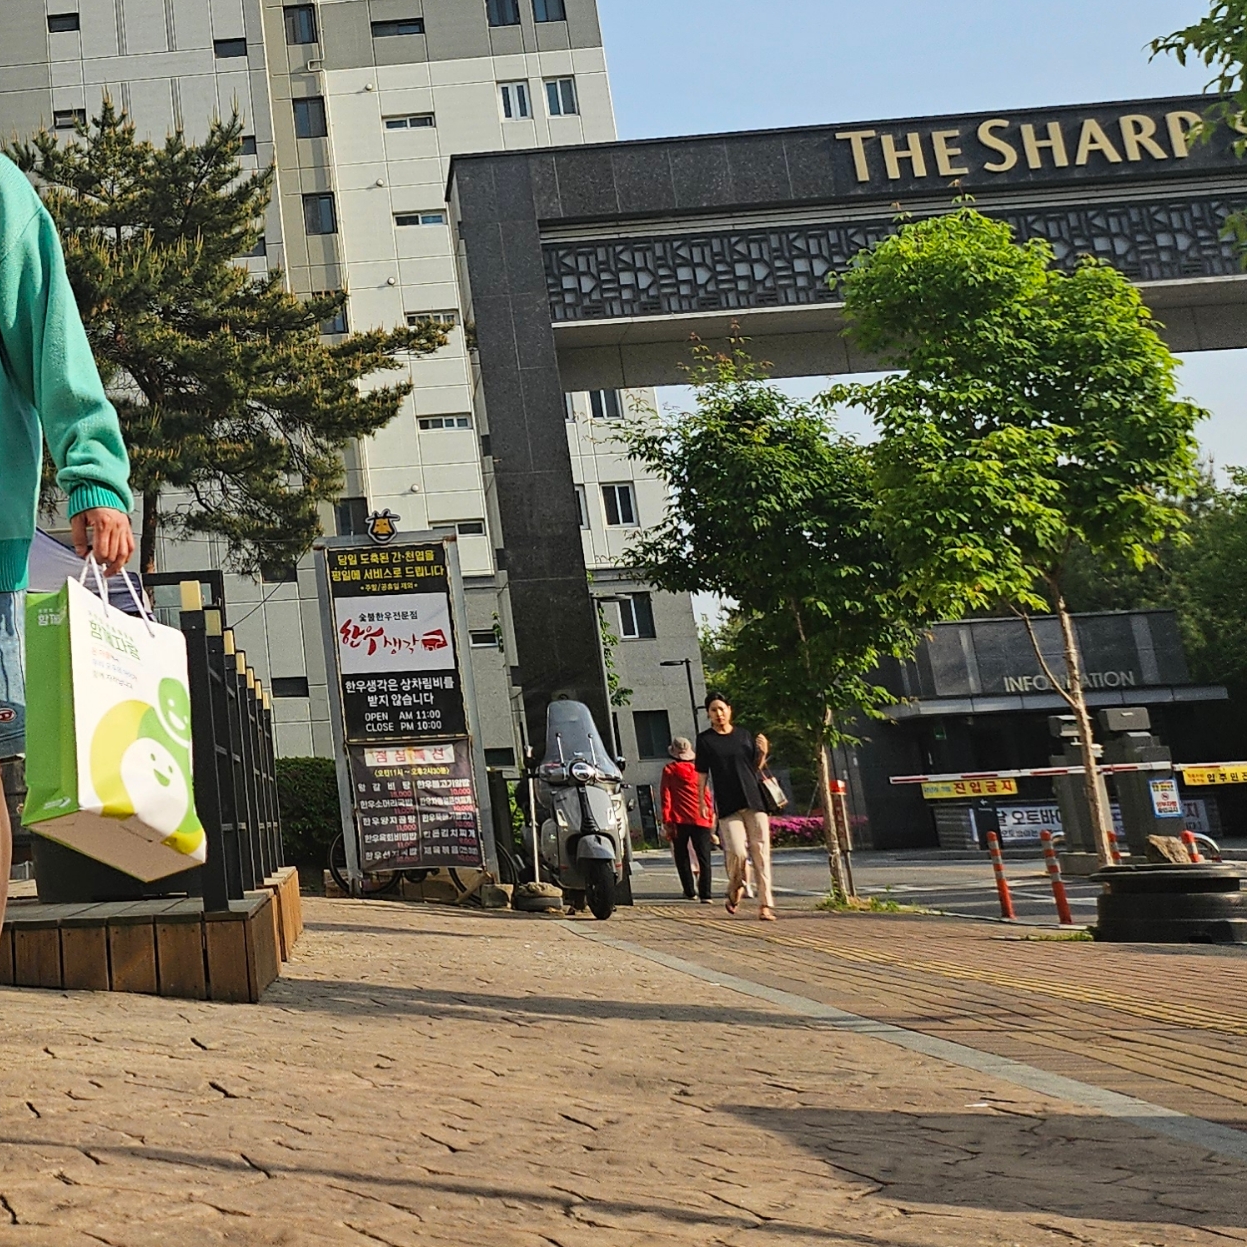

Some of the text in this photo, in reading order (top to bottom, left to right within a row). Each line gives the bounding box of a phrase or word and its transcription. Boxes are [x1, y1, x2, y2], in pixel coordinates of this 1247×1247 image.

[835, 128, 970, 182] THE
[976, 110, 1204, 173] SHARP
[360, 551, 390, 564] 도축된
[363, 567, 403, 581] 서비스로
[405, 565, 445, 578] 드립니다
[358, 610, 418, 623] 숯불한우전문점
[345, 676, 455, 694] 한우생각은 상차림비를
[367, 692, 435, 708] 받지 않습니다
[364, 709, 442, 722] OPEN AM 11:00
[365, 720, 442, 732] CLOSE PM 10:00
[953, 778, 1014, 795] 진입금지
